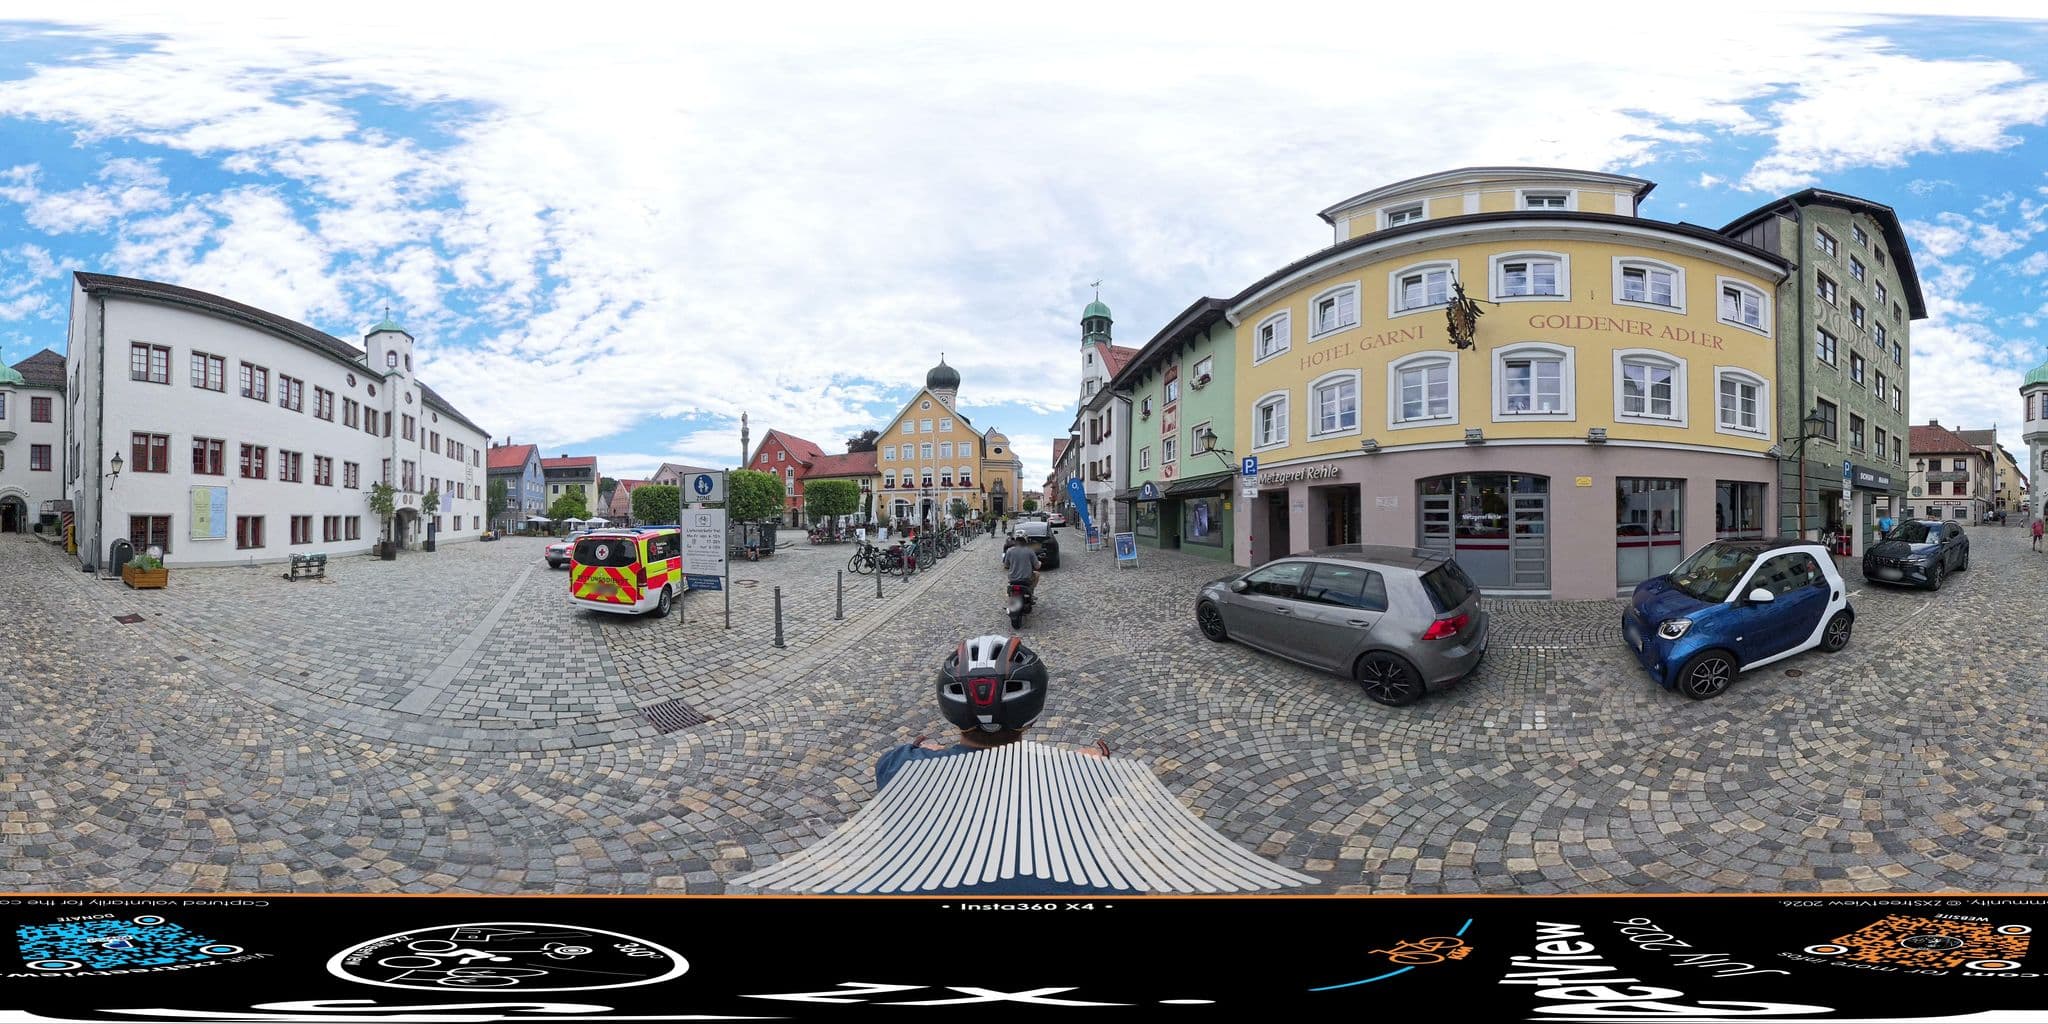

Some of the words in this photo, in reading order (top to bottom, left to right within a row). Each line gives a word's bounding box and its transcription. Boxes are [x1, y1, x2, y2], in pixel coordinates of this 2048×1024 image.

[1529, 314, 1653, 337] GOLDENER
[1660, 325, 1725, 350] ADLER
[1300, 342, 1354, 370] HOTEL
[1360, 325, 1425, 351] GARNI
[1245, 459, 1254, 474] P
[1260, 467, 1305, 485] Metzgerei
[1306, 463, 1339, 480] Rehle
[1844, 462, 1850, 476] P
